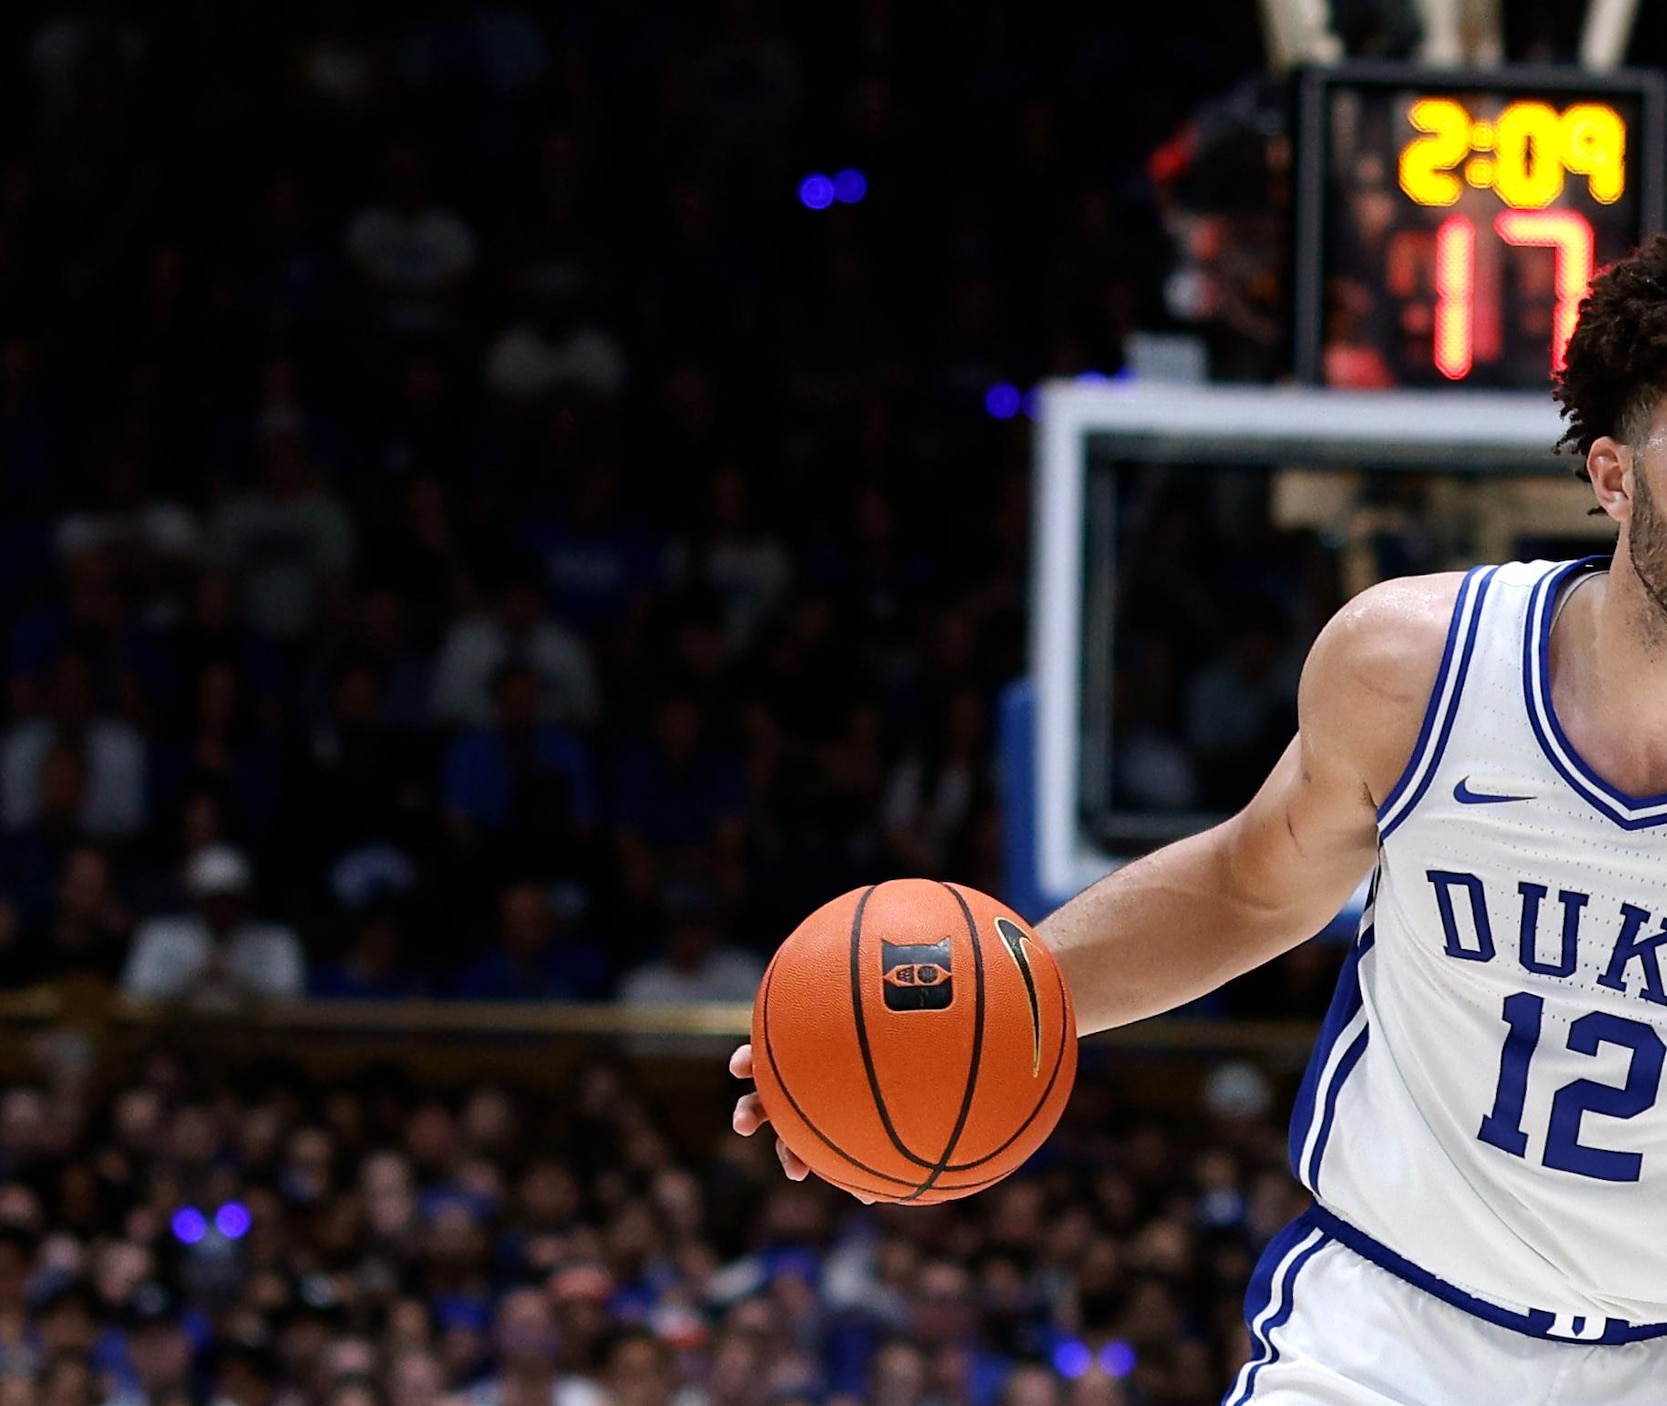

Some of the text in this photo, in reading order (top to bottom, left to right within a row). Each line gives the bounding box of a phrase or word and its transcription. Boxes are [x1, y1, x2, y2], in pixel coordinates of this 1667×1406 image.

[1399, 98, 1626, 208] 2:09
[1434, 210, 1596, 380] 17
[1476, 991, 1667, 1183] 12
